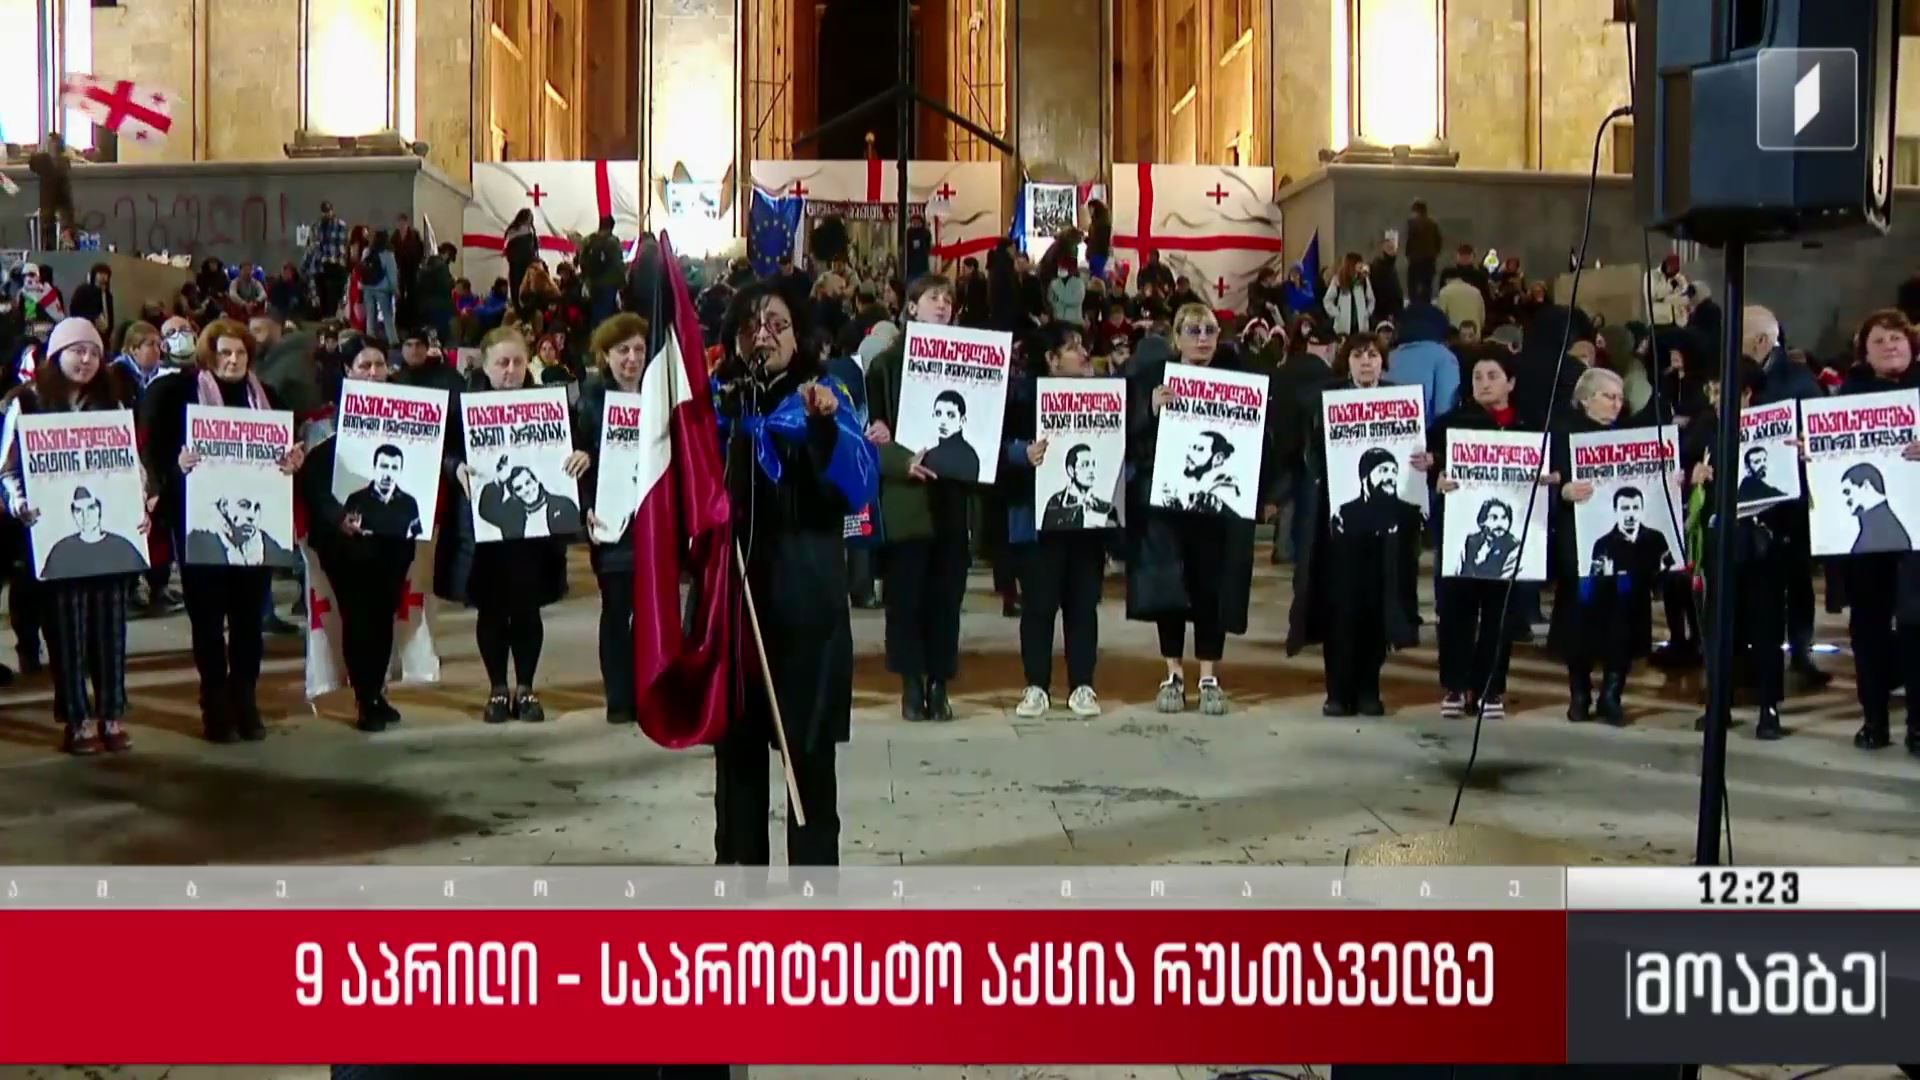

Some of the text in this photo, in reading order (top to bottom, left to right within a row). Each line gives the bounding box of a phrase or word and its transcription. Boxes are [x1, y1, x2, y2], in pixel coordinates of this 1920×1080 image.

[909, 336, 1005, 368] თავისუფლება
[1041, 392, 1122, 413] თავისუფლება
[1168, 376, 1263, 407] თავისუფლება
[344, 393, 442, 423] თავისუფლება
[466, 400, 565, 426] თავისუფლება
[1328, 399, 1420, 424] თავისუფლება
[1807, 404, 1916, 433] თავისუფლება
[25, 424, 131, 452] თავისუფლება
[192, 418, 289, 445] თავისუფლება
